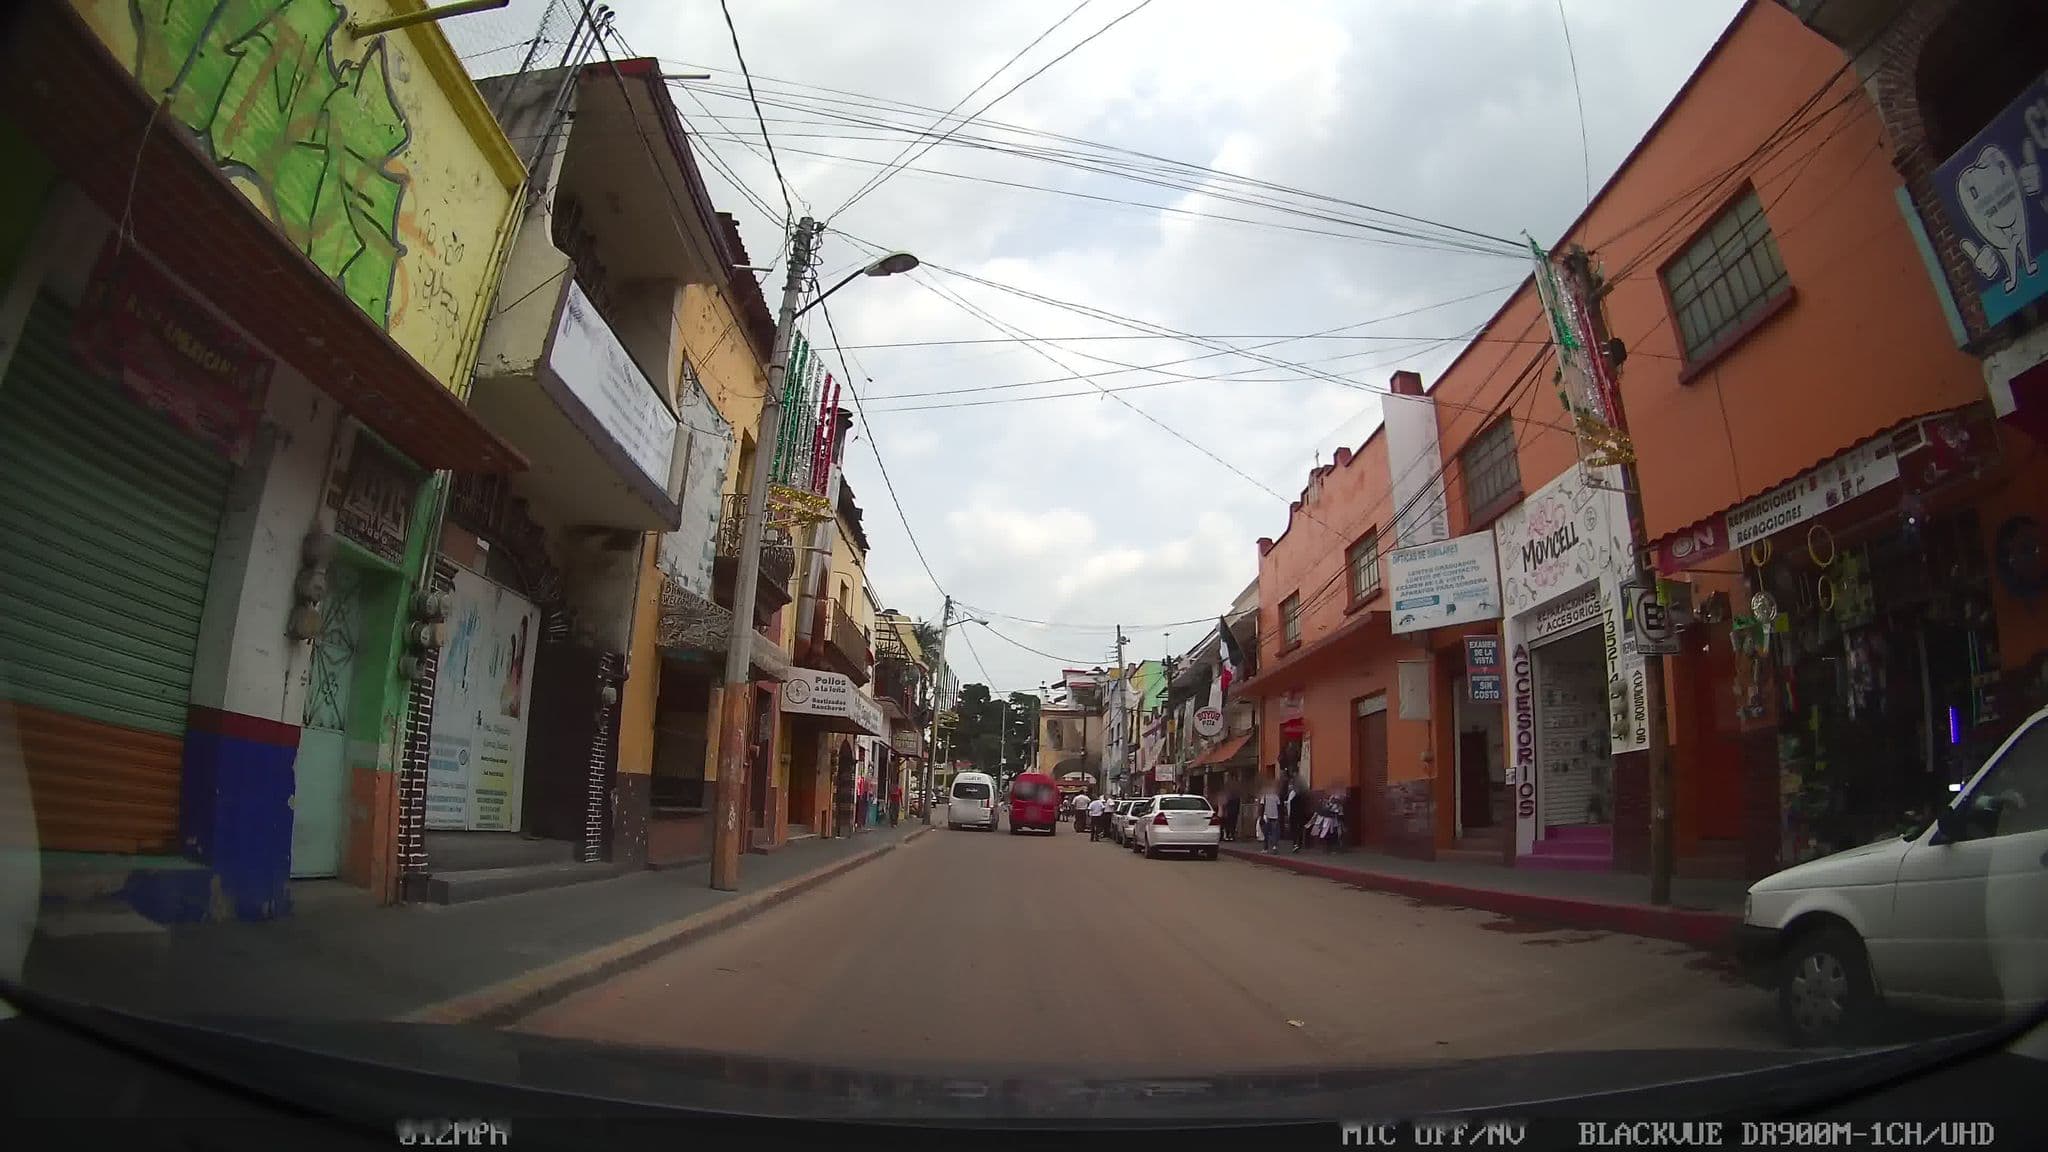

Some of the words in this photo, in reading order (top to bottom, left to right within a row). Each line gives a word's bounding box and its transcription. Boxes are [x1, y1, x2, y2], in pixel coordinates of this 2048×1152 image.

[1522, 522, 1579, 573] MOVICELL
[1536, 624, 1543, 635] Y
[1547, 601, 1601, 632] ACCESORIOS
[1469, 640, 1497, 649] EXAMEN
[1475, 656, 1494, 665] VISTA
[815, 676, 846, 686] Pollos
[1474, 690, 1499, 699] COSTO
[1513, 644, 1535, 817] ACCESORIOS
